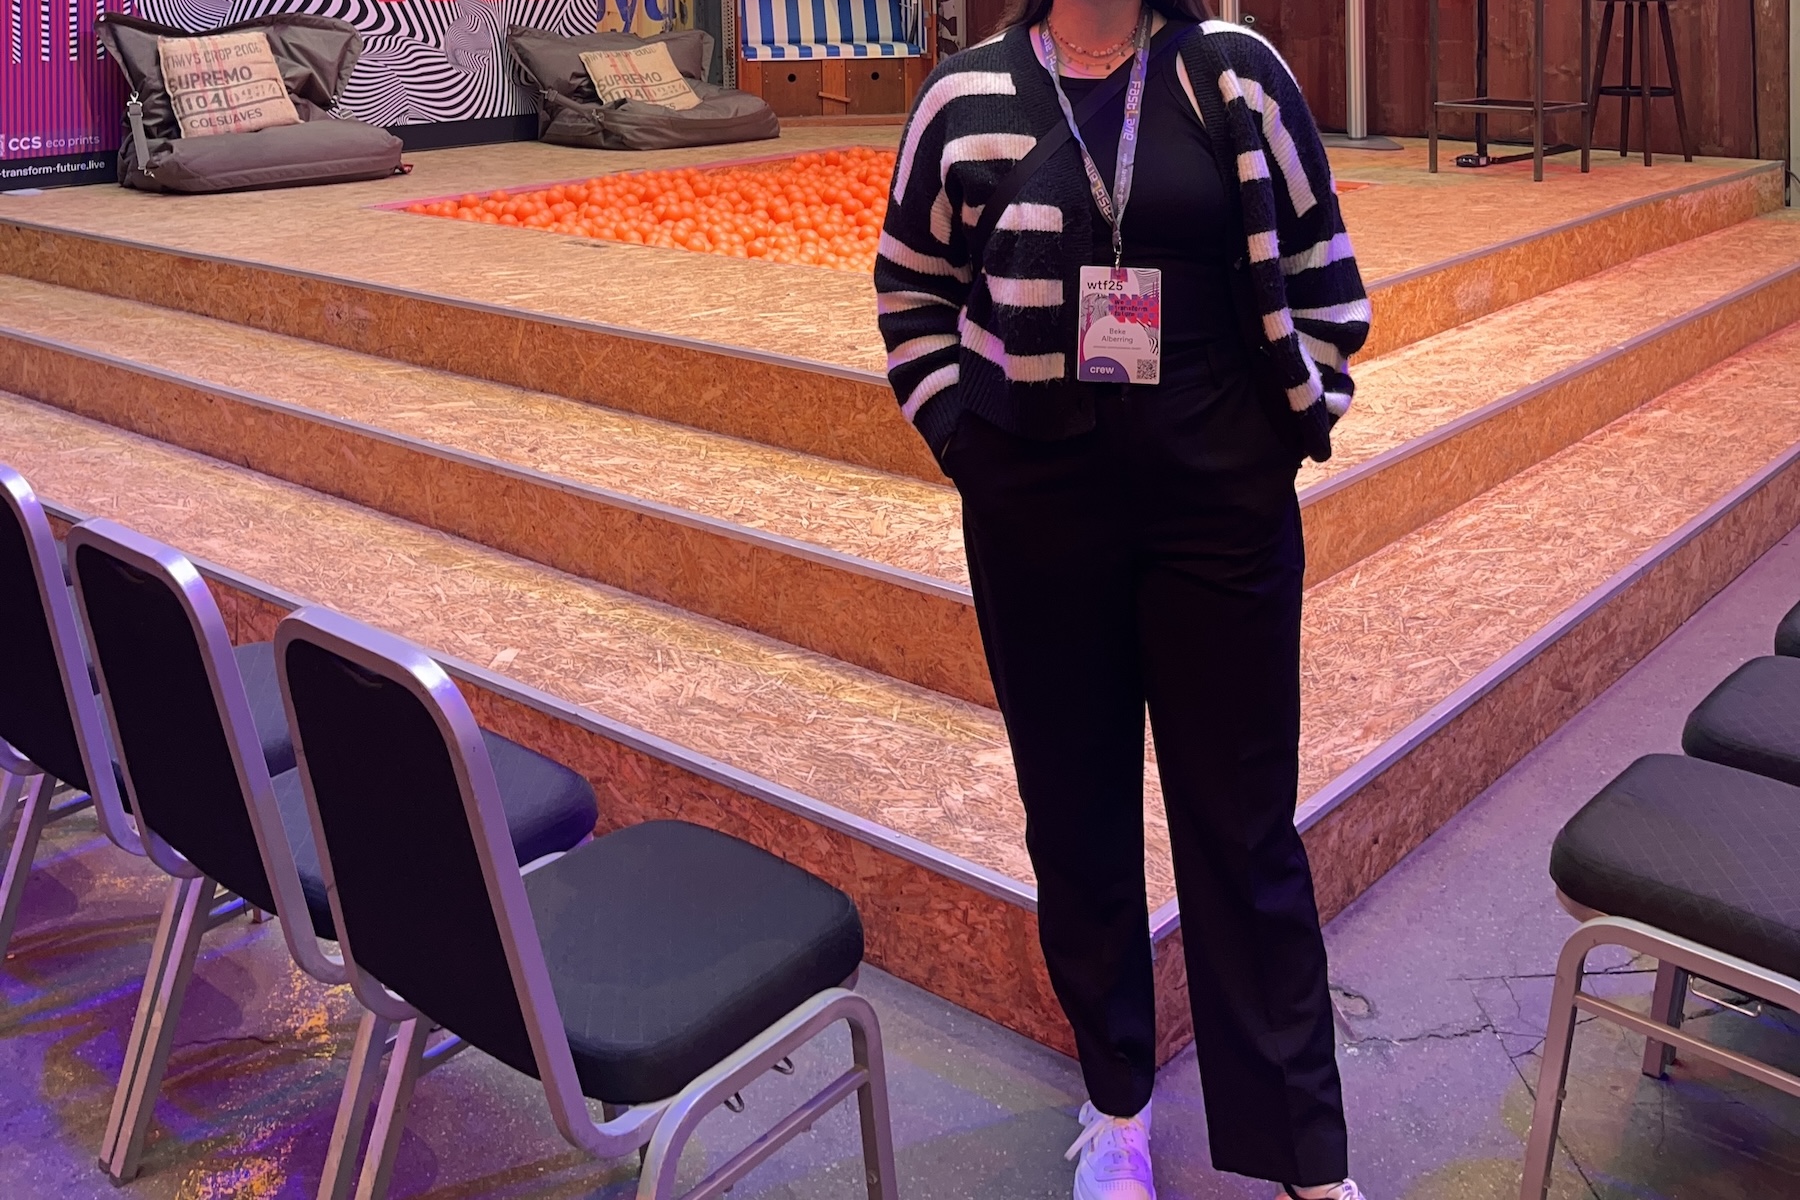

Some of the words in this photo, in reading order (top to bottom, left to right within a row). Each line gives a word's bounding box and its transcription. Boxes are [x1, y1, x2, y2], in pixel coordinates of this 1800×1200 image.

[168, 66, 253, 94] SUPREMO
[597, 71, 663, 94] SUPREMO
[1122, 80, 1141, 142] FastLane
[8, 136, 42, 151] CCS
[46, 139, 66, 148] eco
[68, 135, 100, 149] prints
[1087, 280, 1124, 291] wtf25
[1090, 366, 1115, 374] crew
